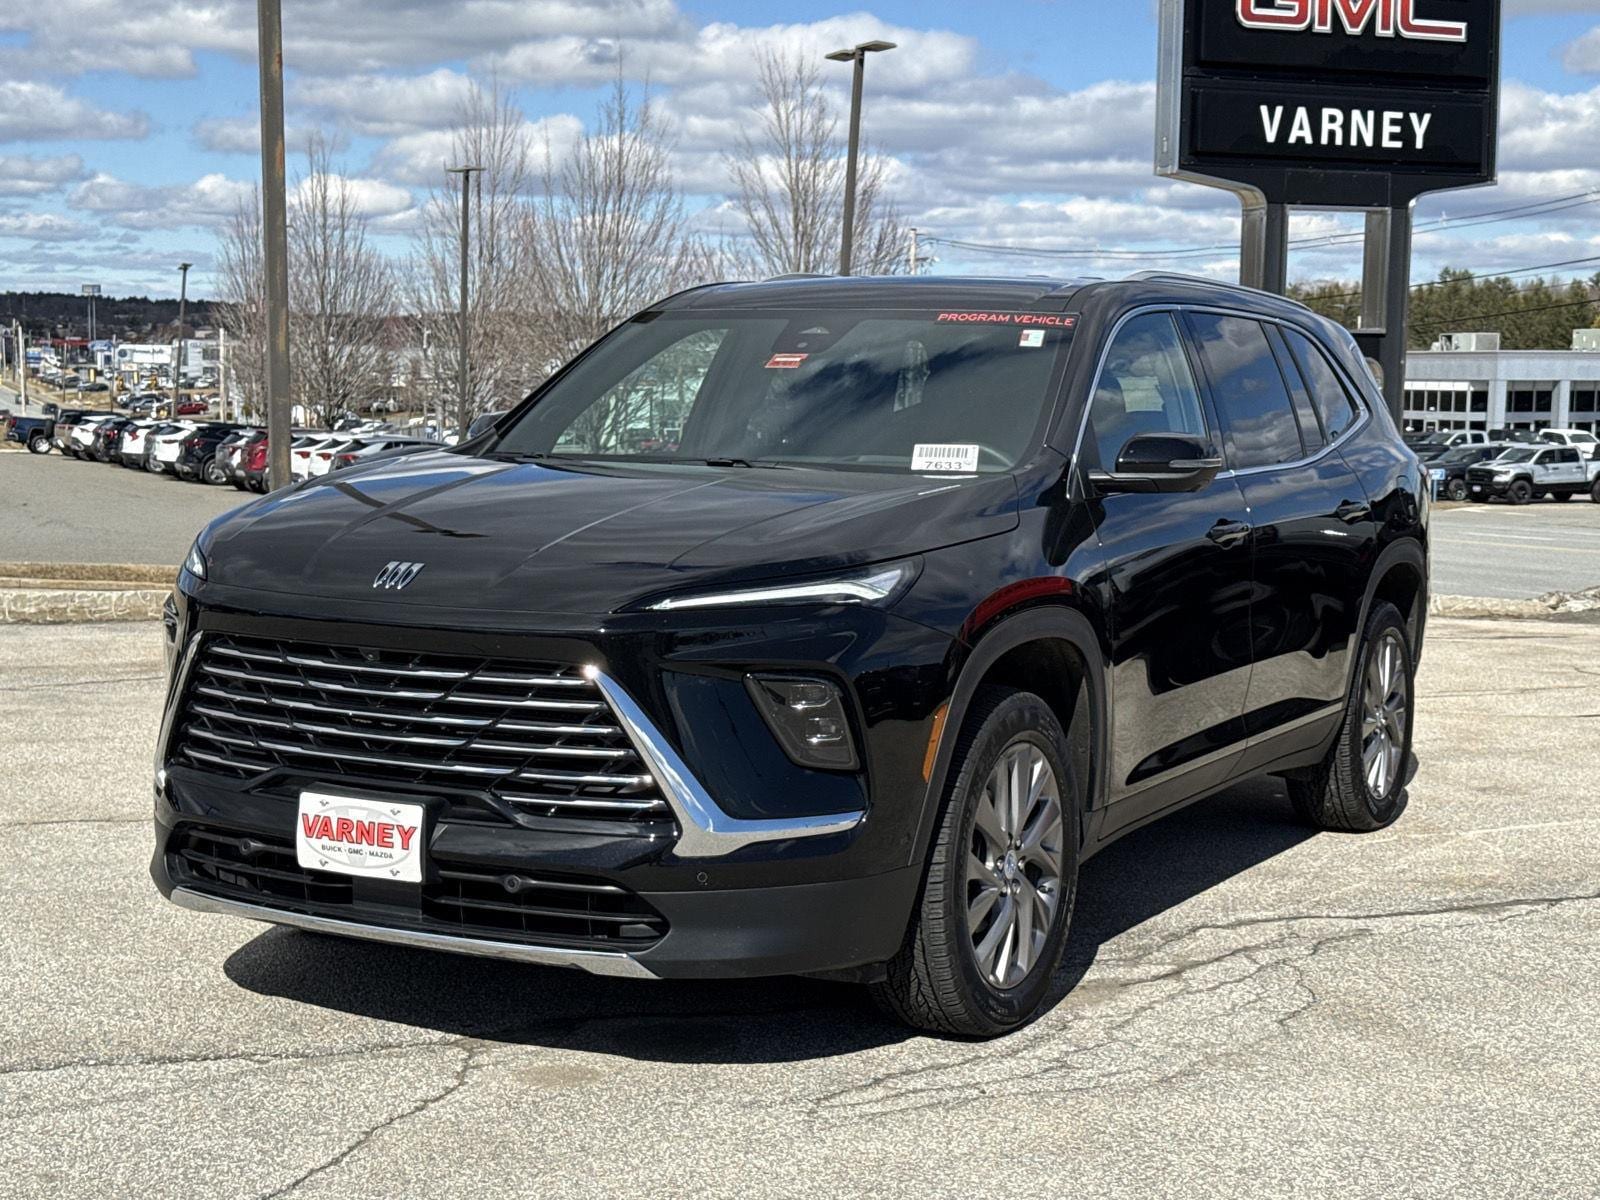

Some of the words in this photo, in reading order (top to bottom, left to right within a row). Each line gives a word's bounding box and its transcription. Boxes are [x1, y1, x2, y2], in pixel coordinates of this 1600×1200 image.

[1236, 0, 1468, 42] GMC
[1259, 104, 1432, 150] VARNEY
[937, 313, 1009, 322] PROGRAM
[1014, 315, 1075, 327] VEHICLE
[925, 461, 962, 469] 7633
[302, 813, 418, 851] VARNEY
[321, 844, 343, 853] BUICK
[348, 847, 364, 856] GMC
[369, 851, 394, 860] MAZDA
